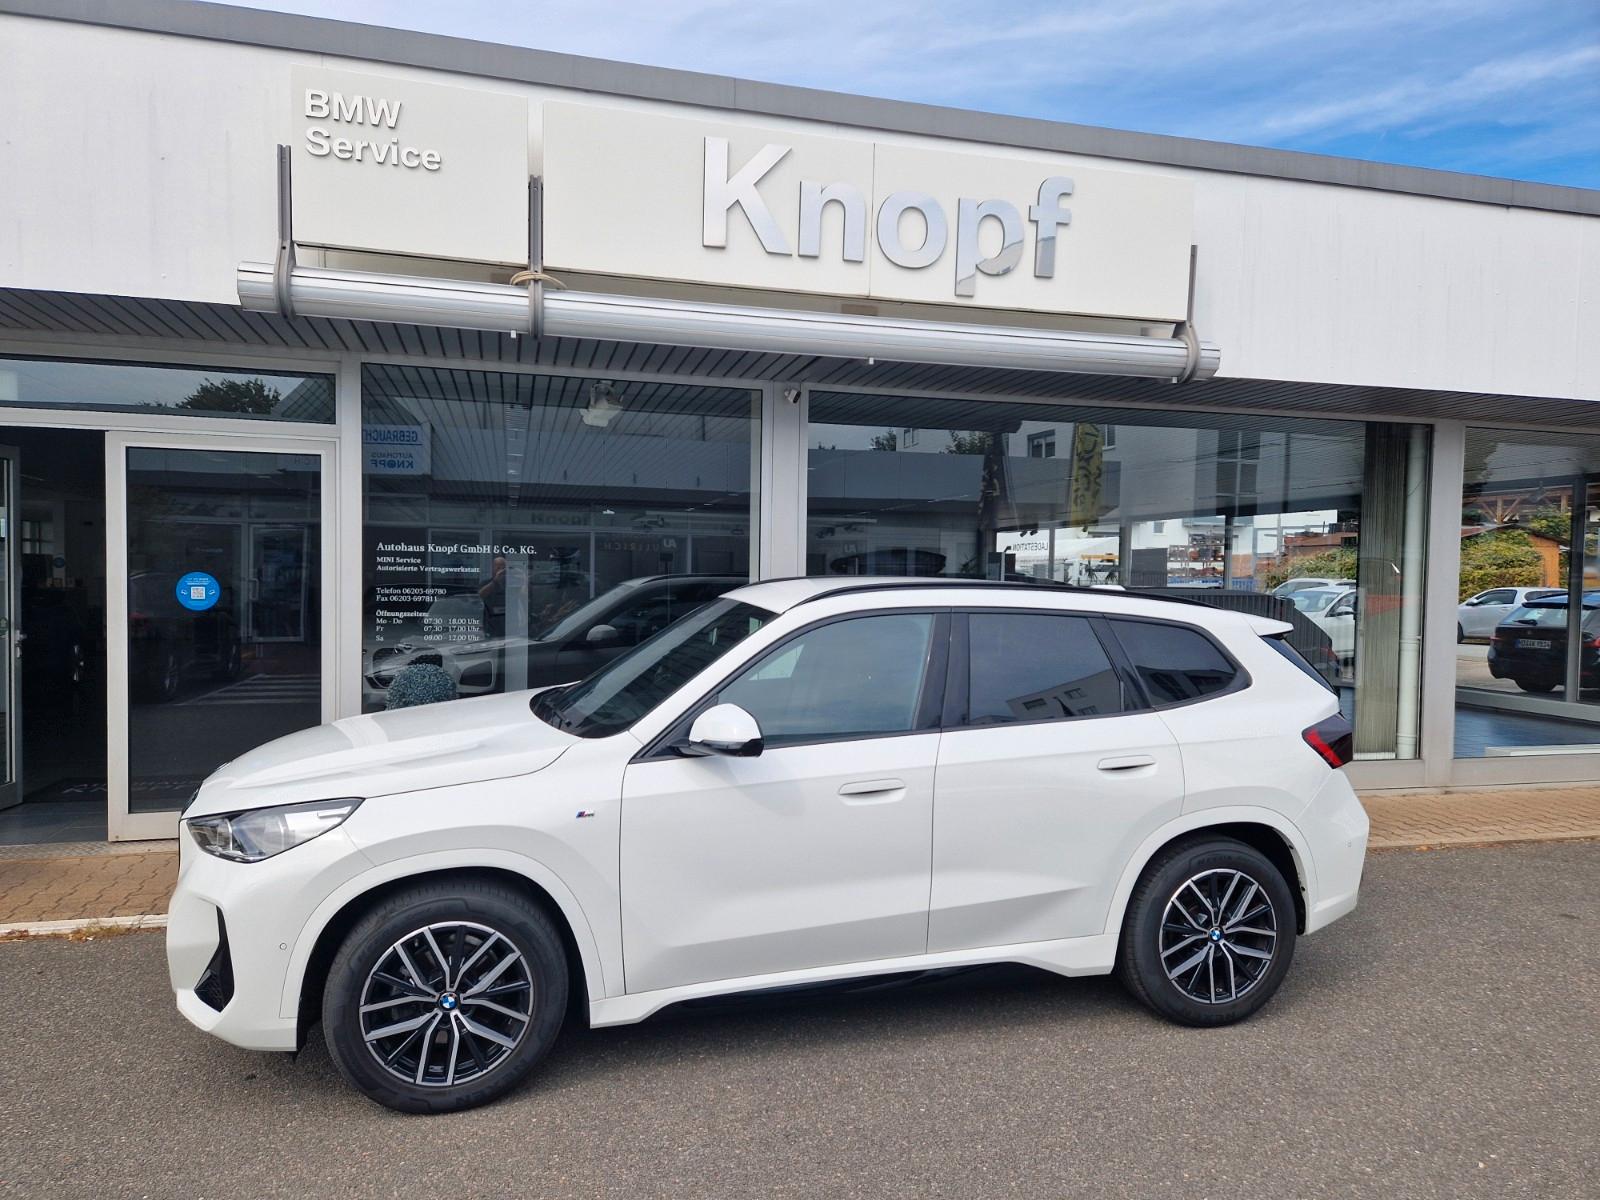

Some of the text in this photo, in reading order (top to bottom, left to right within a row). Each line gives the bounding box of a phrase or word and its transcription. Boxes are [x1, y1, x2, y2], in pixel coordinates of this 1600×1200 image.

[304, 87, 402, 130] BMW
[305, 126, 442, 172] Service
[701, 136, 1074, 298] Knopf
[376, 542, 537, 555] Autohaus Knopf GmbH & Co. KG.
[419, 565, 480, 574] Vertragswerkstatt
